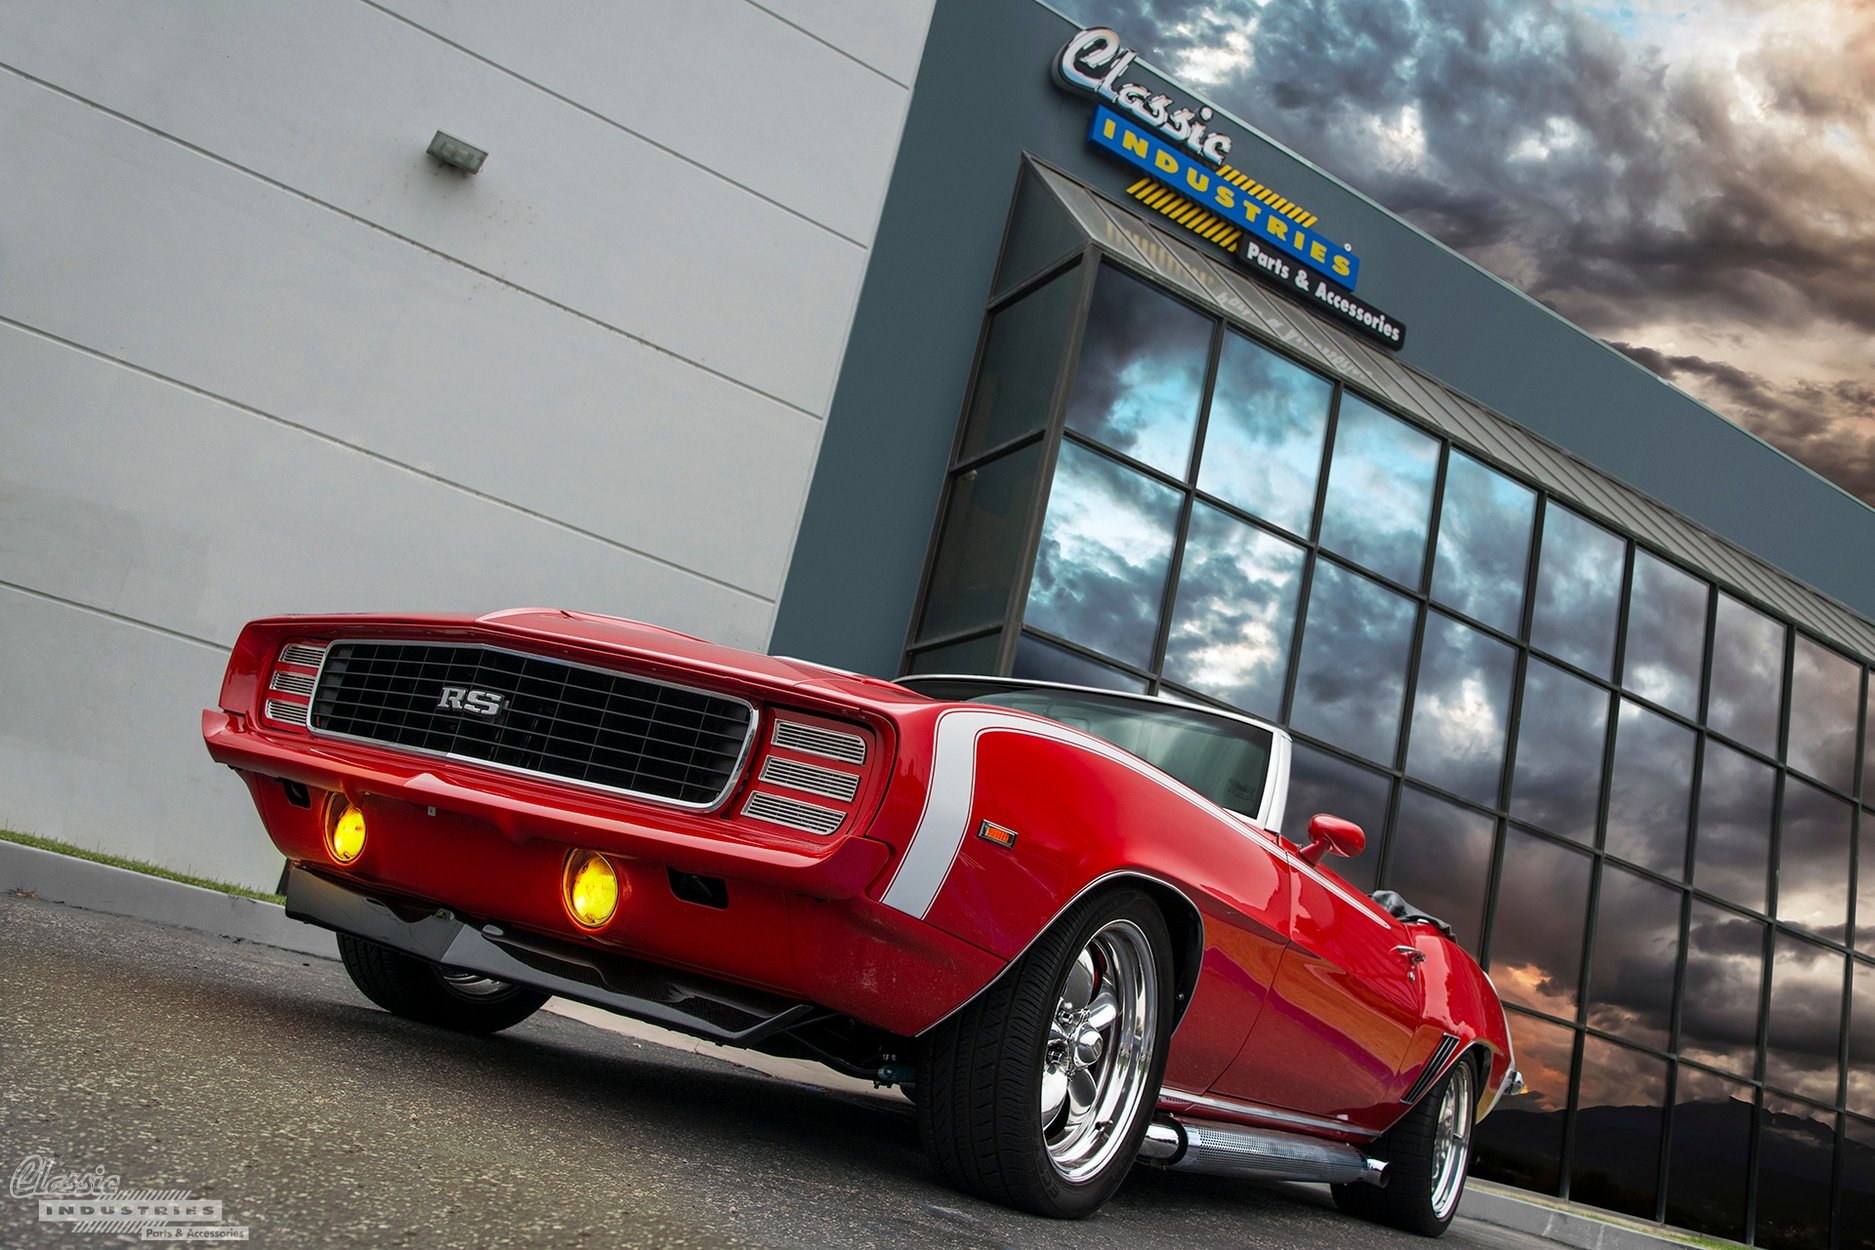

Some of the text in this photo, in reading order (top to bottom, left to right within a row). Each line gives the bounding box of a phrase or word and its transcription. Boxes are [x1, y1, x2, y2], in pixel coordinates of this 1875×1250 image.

[1062, 28, 1232, 164] Classic
[1103, 118, 1352, 277] INDUSTRIES
[1246, 241, 1291, 280] Parts
[1295, 268, 1310, 291] &
[1314, 281, 1400, 341] Accessories
[437, 687, 504, 716] RS
